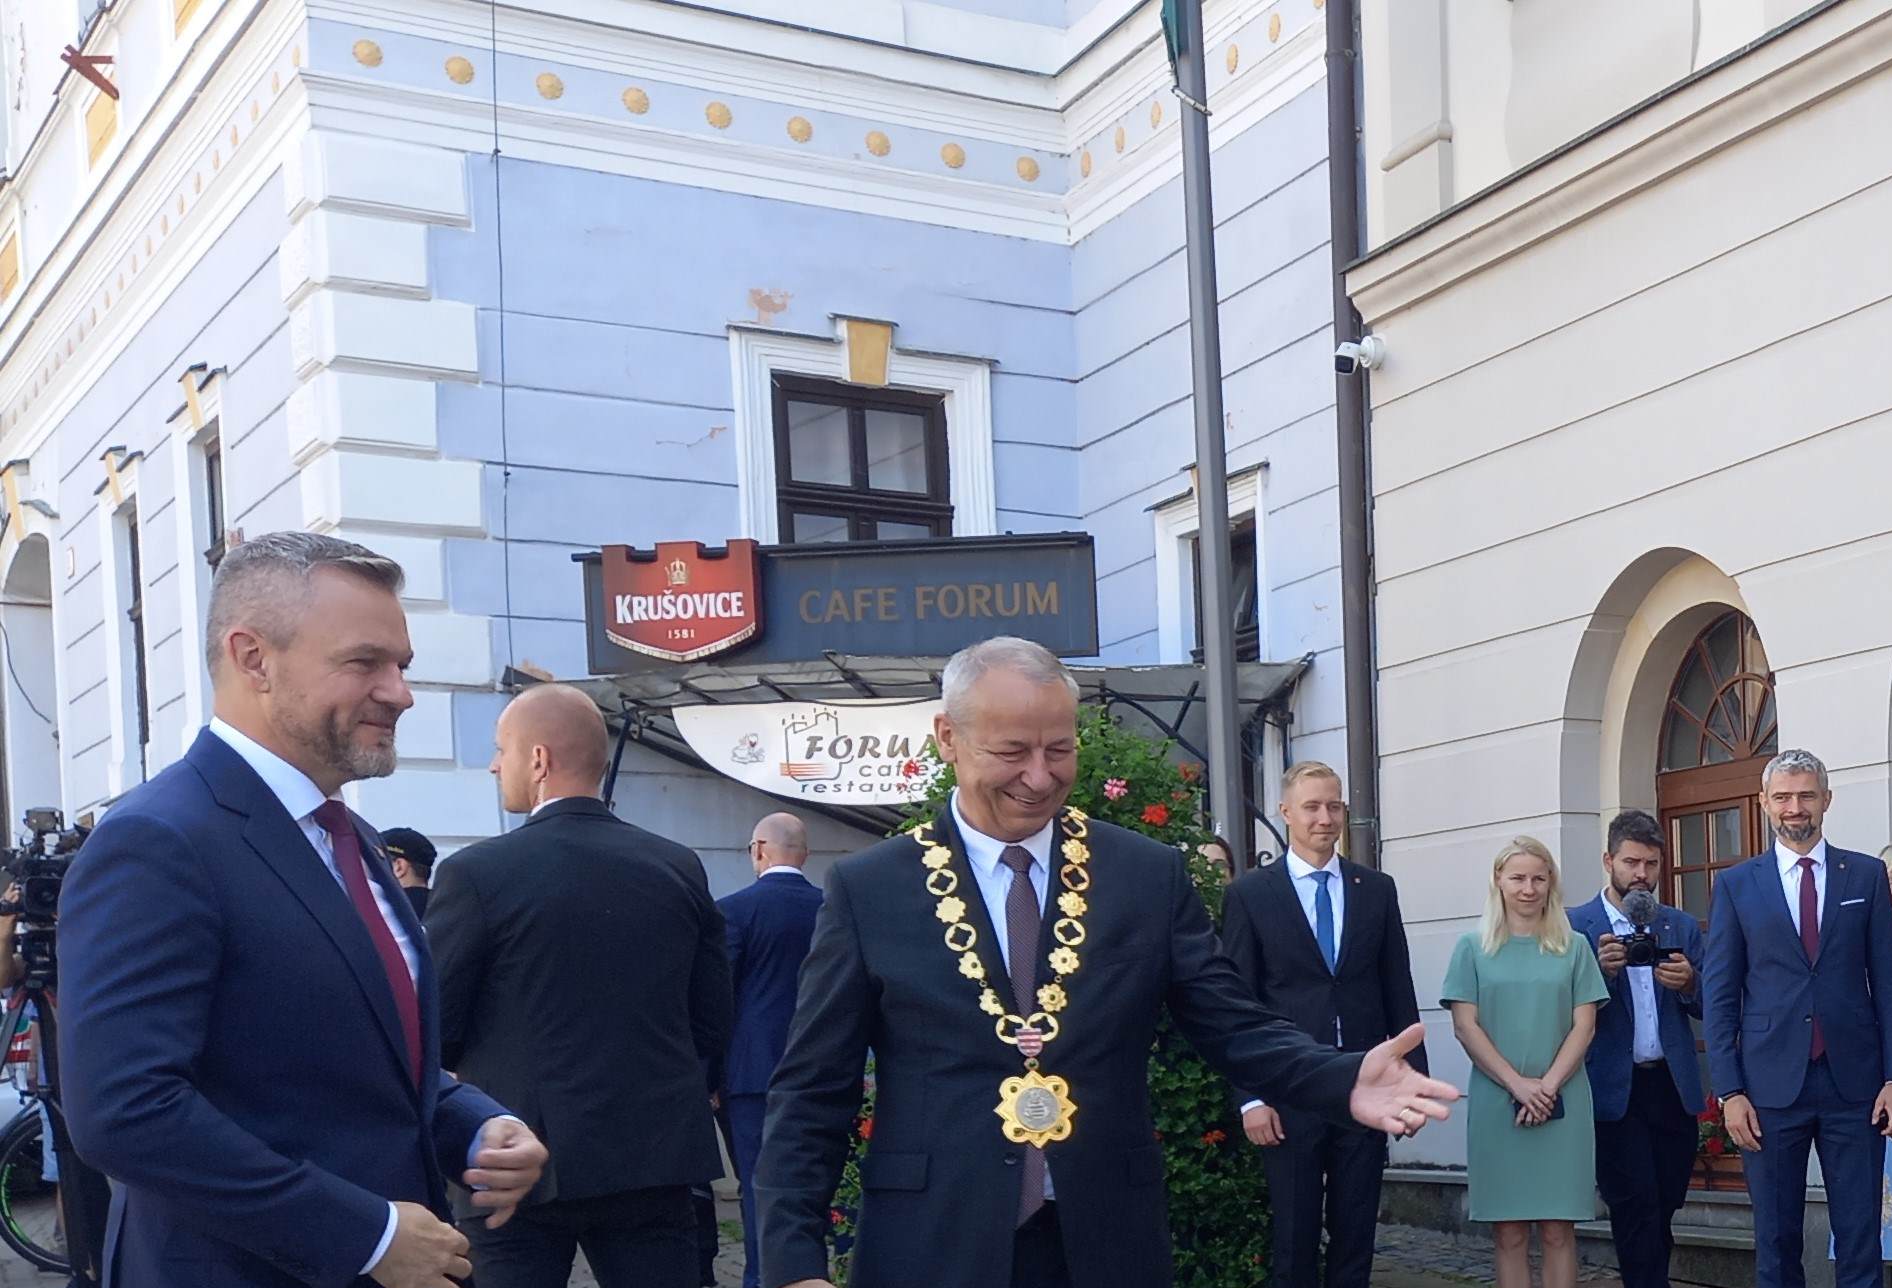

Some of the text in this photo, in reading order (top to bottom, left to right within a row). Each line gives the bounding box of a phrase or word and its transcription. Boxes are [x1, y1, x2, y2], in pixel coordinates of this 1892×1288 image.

[615, 589, 745, 624] KRUŠOVICE
[799, 581, 1060, 624] CAFE FORUM
[667, 629, 695, 639] 1581
[858, 760, 930, 777] cafe
